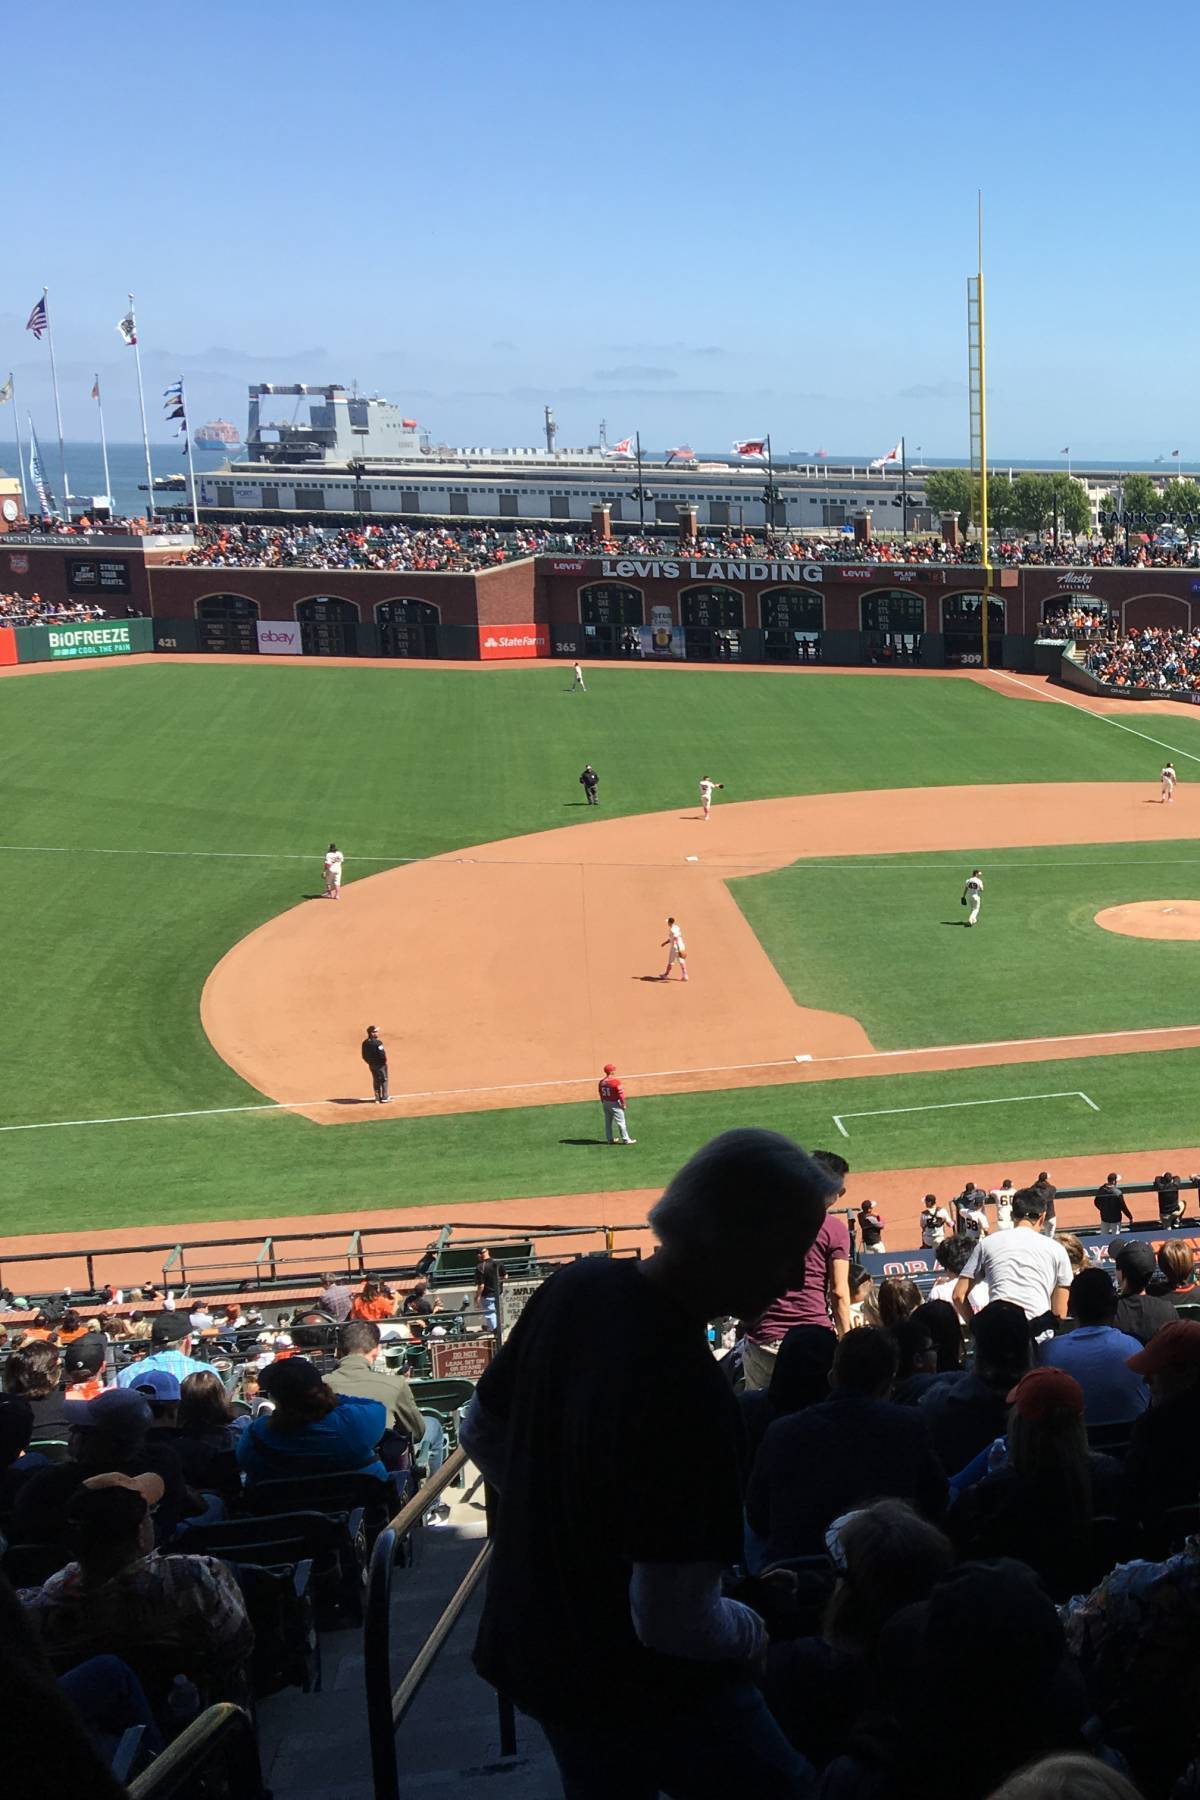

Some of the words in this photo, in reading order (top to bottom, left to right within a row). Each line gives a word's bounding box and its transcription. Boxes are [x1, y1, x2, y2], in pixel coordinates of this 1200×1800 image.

[1098, 511, 1149, 524] BANK
[1154, 511, 1177, 524] OF
[690, 562, 824, 583] LANDING
[158, 638, 177, 648] 421
[556, 642, 576, 652] 365
[78, 646, 97, 655] COOL
[100, 645, 113, 653] THE
[115, 644, 131, 652] PAIN
[961, 653, 981, 664] 309
[966, 1217, 978, 1231] 58
